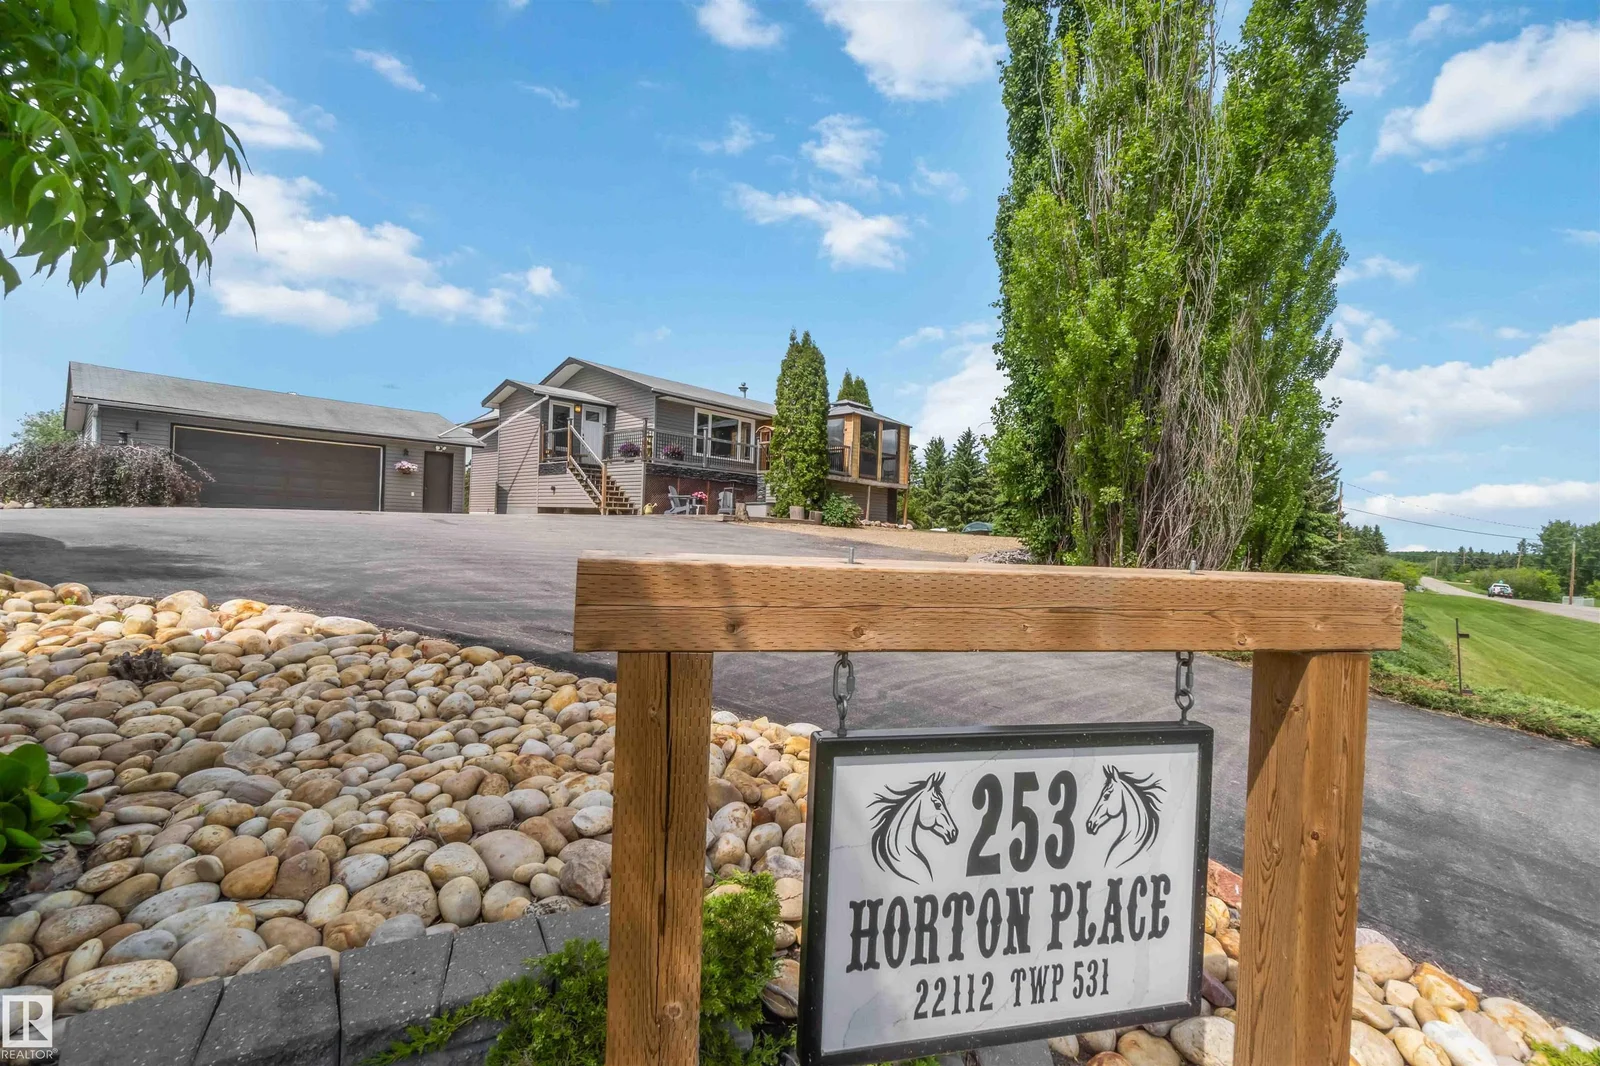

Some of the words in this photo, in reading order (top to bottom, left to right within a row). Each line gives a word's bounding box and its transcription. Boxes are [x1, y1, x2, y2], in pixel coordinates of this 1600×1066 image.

[966, 770, 1077, 877] 253
[846, 886, 1034, 973] HORTON
[1047, 873, 1171, 951] PLACE
[913, 971, 994, 1020] 22112
[1010, 963, 1064, 1008] TWP
[1073, 958, 1110, 999] 531
